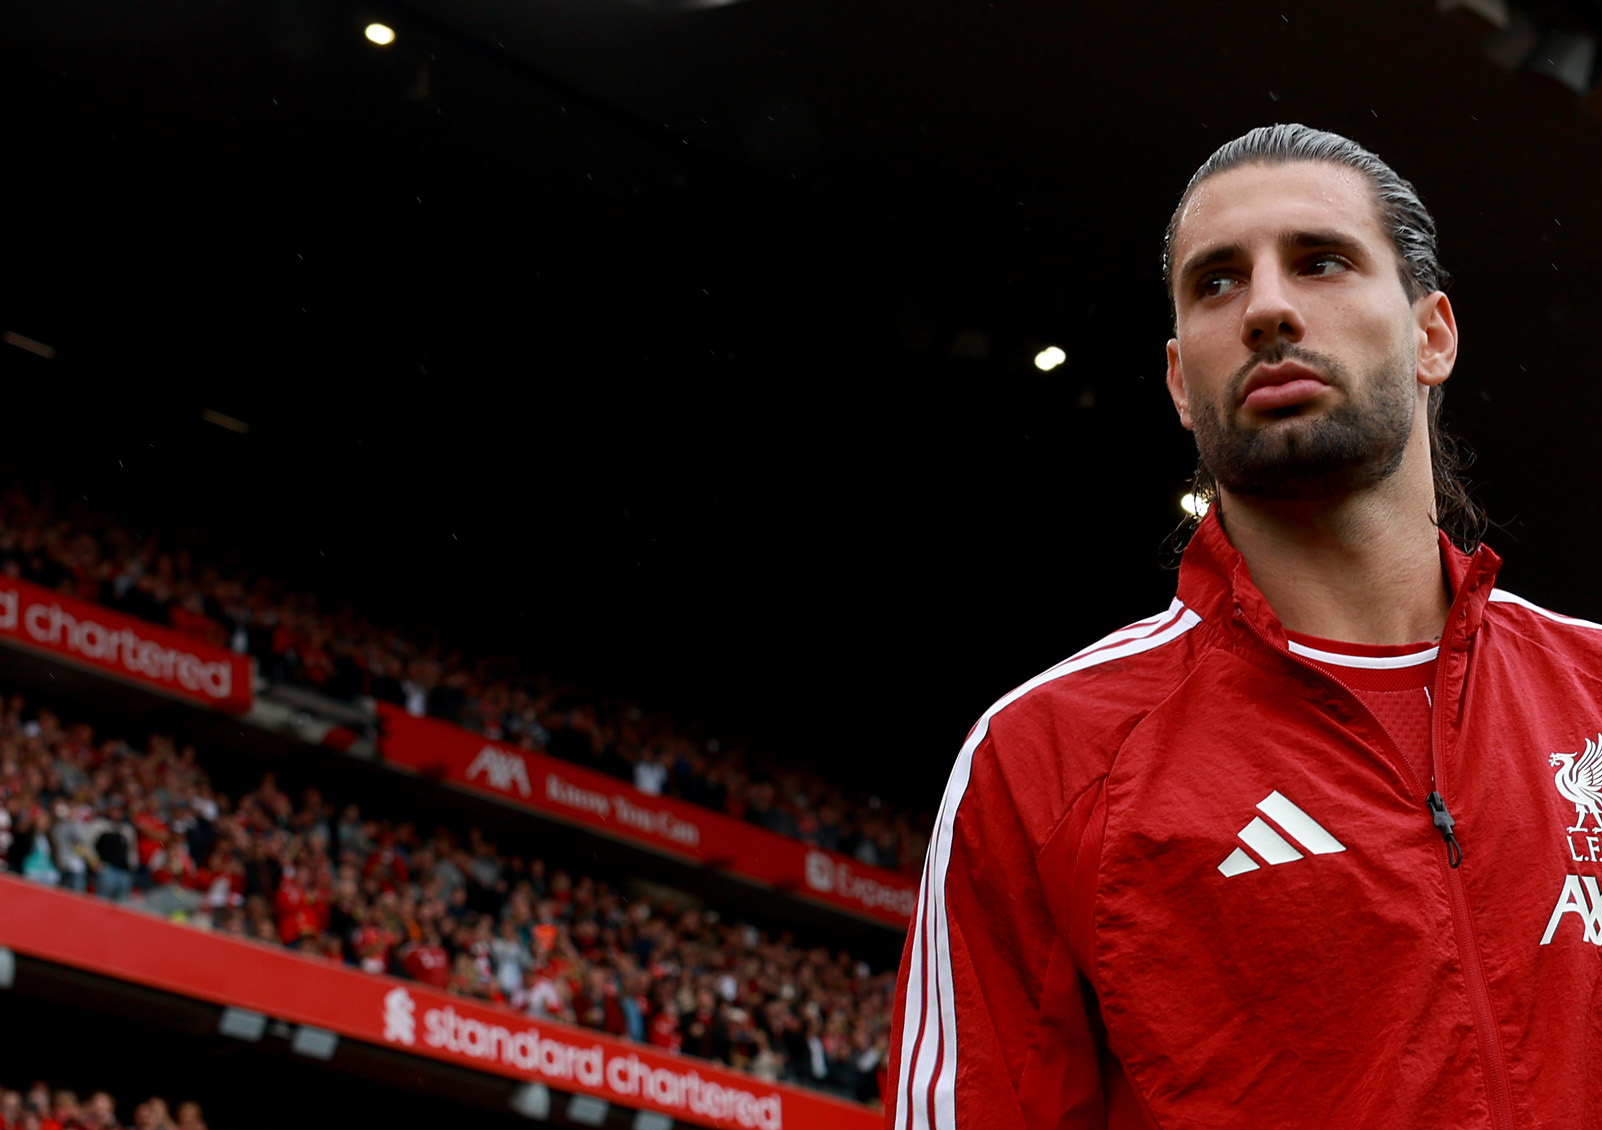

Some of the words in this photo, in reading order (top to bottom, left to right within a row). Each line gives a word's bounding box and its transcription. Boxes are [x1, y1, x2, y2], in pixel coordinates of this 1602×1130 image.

[25, 602, 233, 699] chartered
[465, 744, 532, 800] AXA
[836, 863, 917, 917] Exped
[424, 1005, 604, 1087] standard
